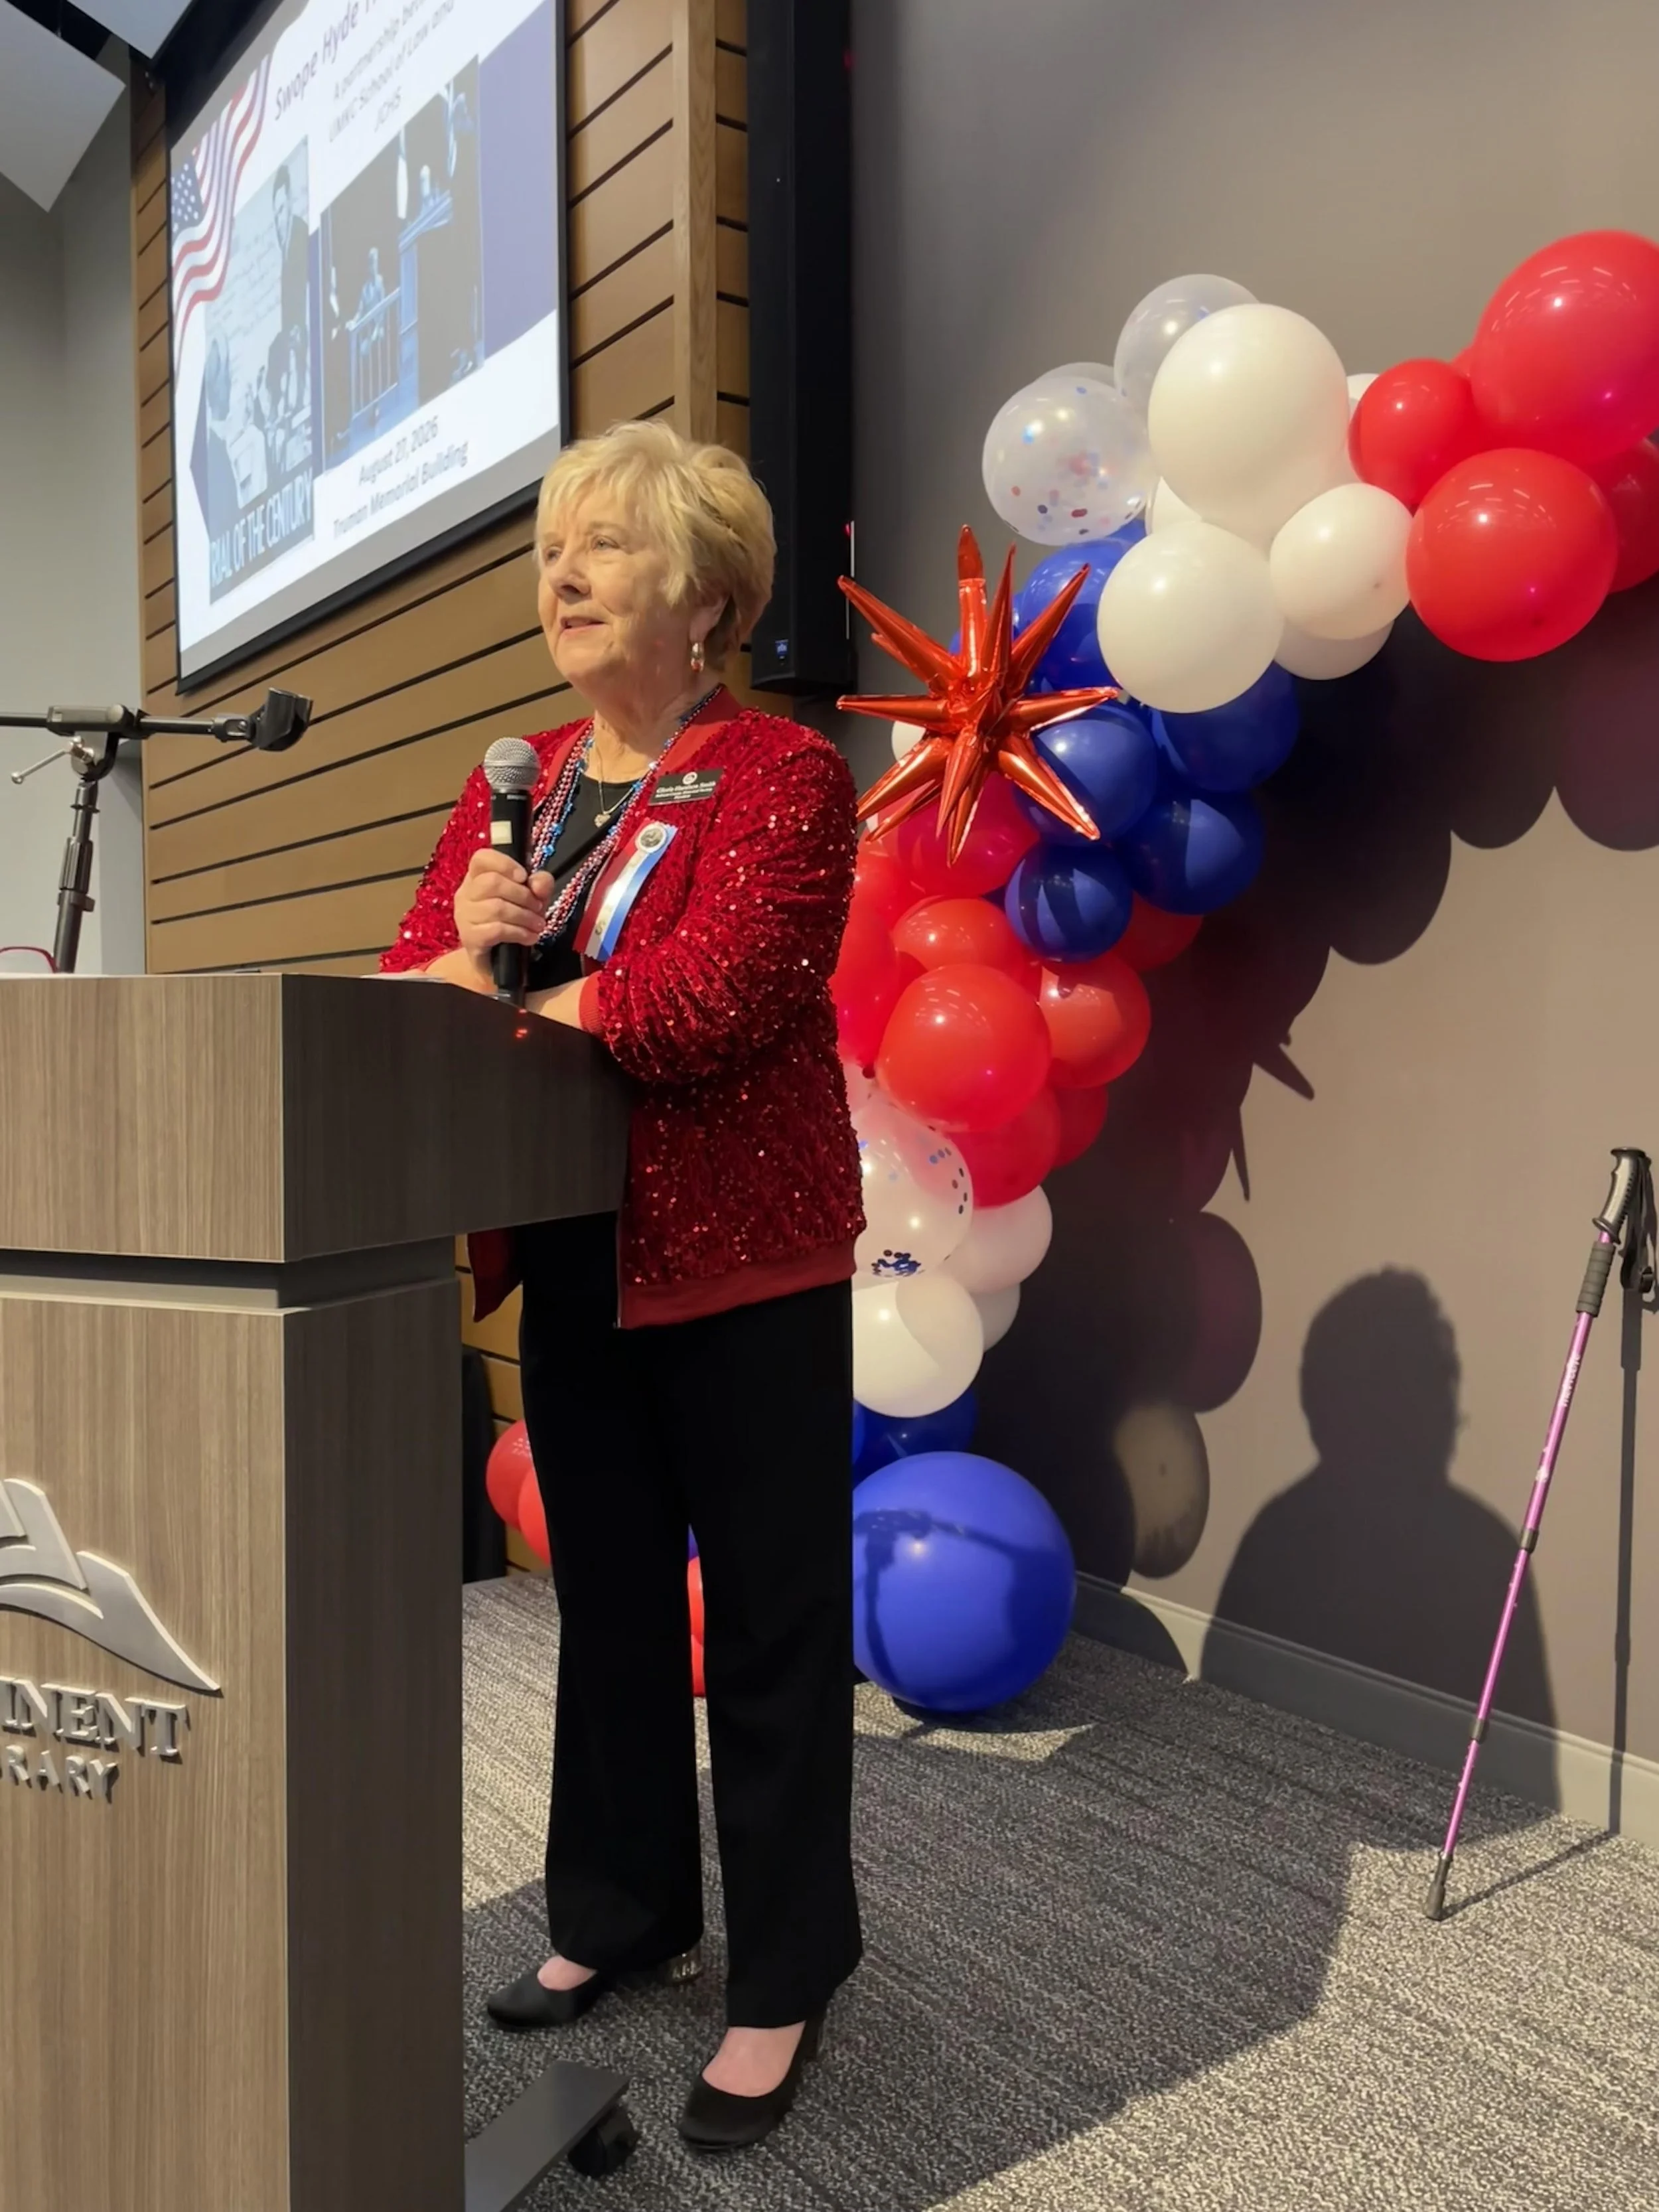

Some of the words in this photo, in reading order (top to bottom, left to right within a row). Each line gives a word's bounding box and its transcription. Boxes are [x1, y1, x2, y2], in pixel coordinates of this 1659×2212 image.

[275, 51, 318, 121] Swope
[322, 0, 359, 64] Hyde
[359, 449, 394, 486] August
[370, 465, 419, 516] Memorial
[421, 441, 469, 485] Building
[233, 518, 246, 573] OF
[246, 504, 265, 562] THE
[266, 466, 313, 549] CENTURY
[5, 1743, 119, 1795] RARY
